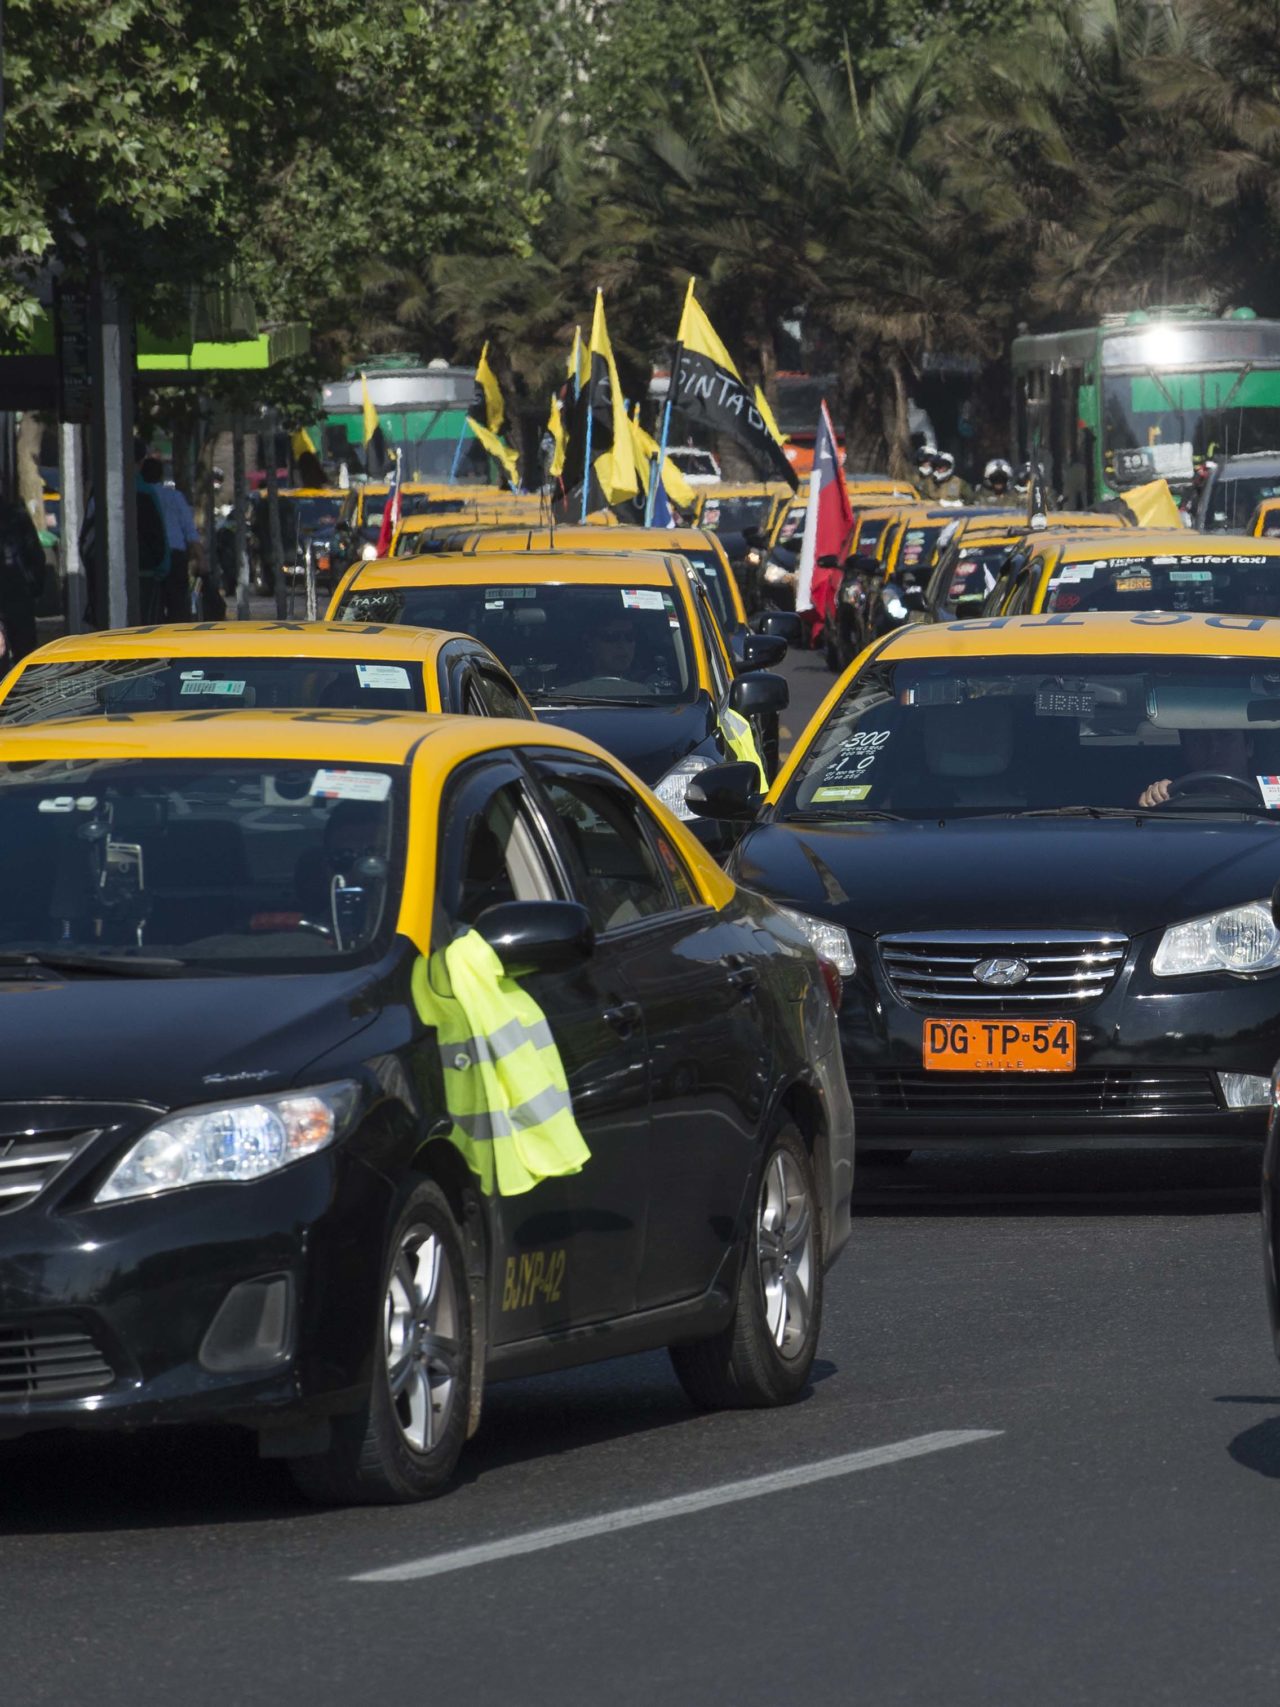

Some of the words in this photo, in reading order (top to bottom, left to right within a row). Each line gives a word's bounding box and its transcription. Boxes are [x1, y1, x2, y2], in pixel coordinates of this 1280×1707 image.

[1180, 556, 1267, 565] SaferTaxi
[353, 596, 388, 606] TAXI
[1038, 693, 1092, 712] LIBRE
[975, 1060, 1025, 1069] CHILE
[502, 1249, 566, 1312] BJYP-42
